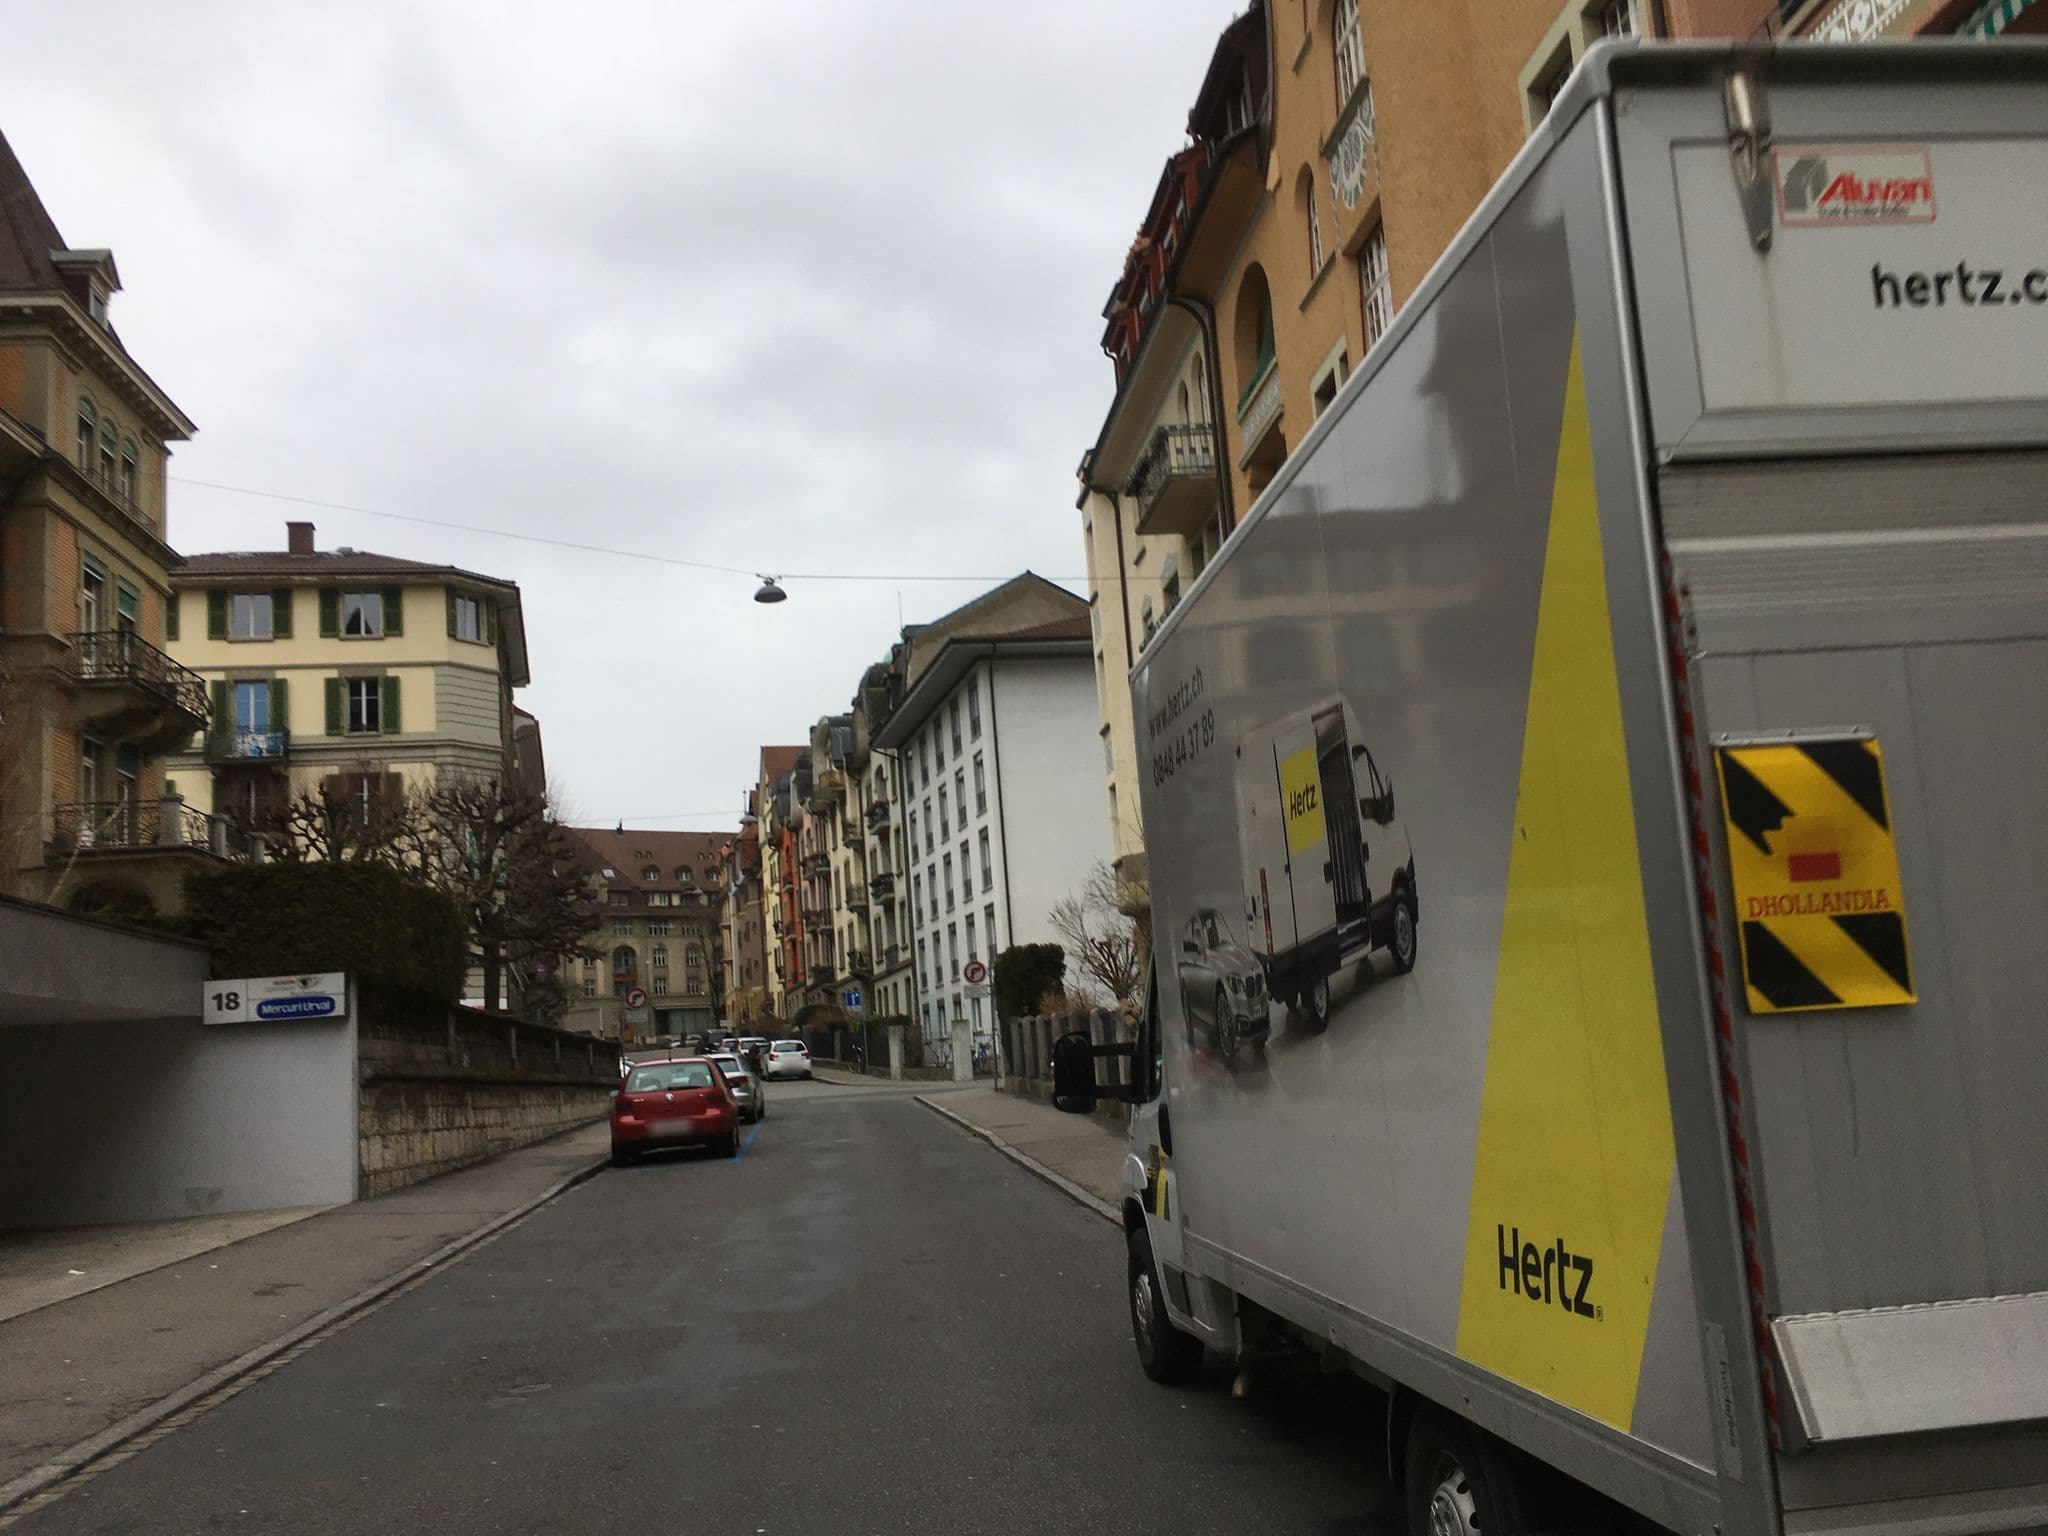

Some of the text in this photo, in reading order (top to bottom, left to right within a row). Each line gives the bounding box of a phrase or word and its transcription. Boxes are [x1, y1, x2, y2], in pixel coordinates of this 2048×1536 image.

[1871, 259, 2048, 309] hertz.c
[1149, 664, 1204, 741] www.hertz.ch
[1153, 709, 1215, 787] 0848 44 37 89
[1290, 784, 1316, 820] Hertz
[1747, 889, 1891, 918] DHOLLANDIA
[212, 992, 240, 1011] 18
[261, 1001, 302, 1014] Mercuri
[1497, 1223, 1595, 1320] Hertz
